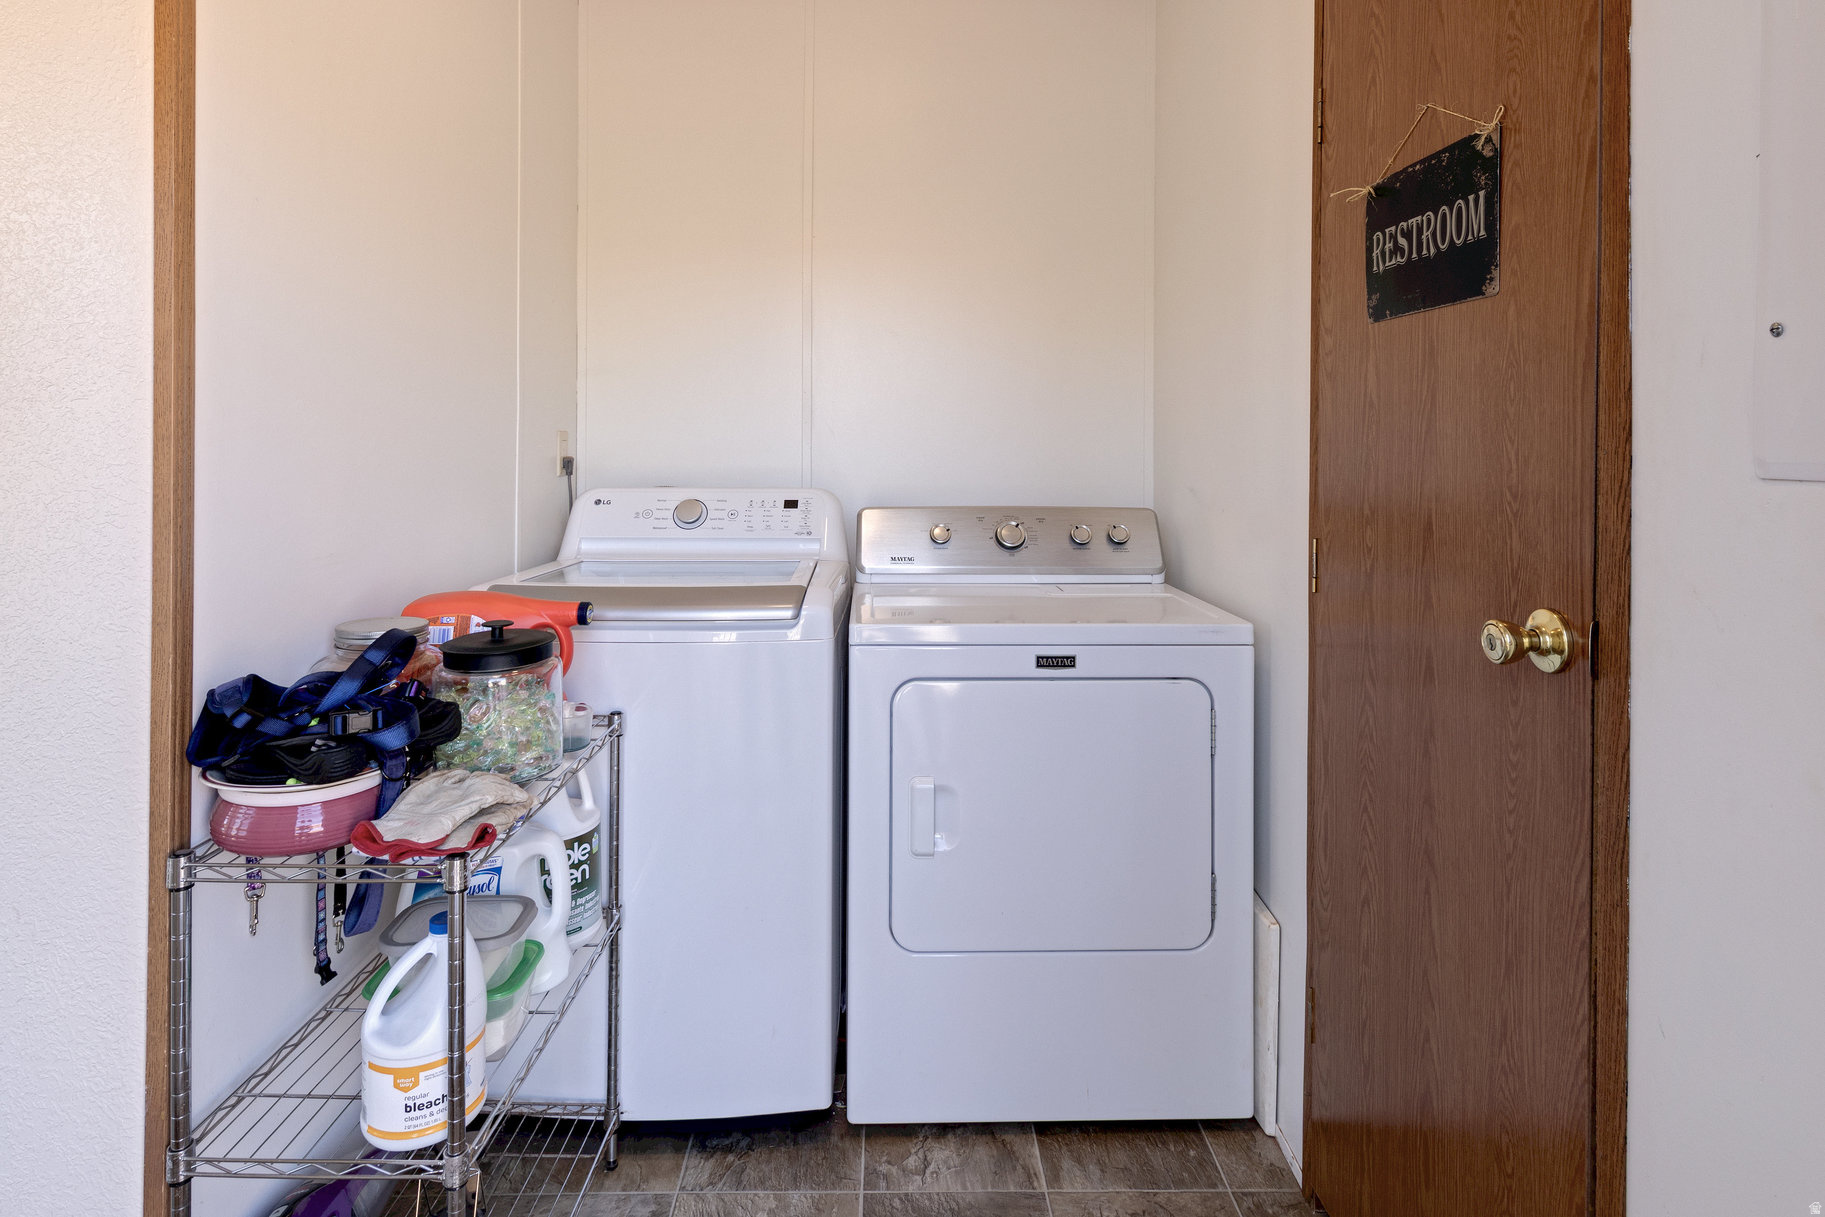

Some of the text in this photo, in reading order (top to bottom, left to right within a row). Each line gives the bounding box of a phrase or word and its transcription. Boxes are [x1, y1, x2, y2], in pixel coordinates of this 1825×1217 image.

[1372, 189, 1487, 274] RESTROOM
[1037, 657, 1075, 666] MAYTAG
[467, 876, 495, 896] ysol
[404, 1092, 430, 1102] regular
[404, 1093, 448, 1113] bleach
[404, 1113, 428, 1123] cleans
